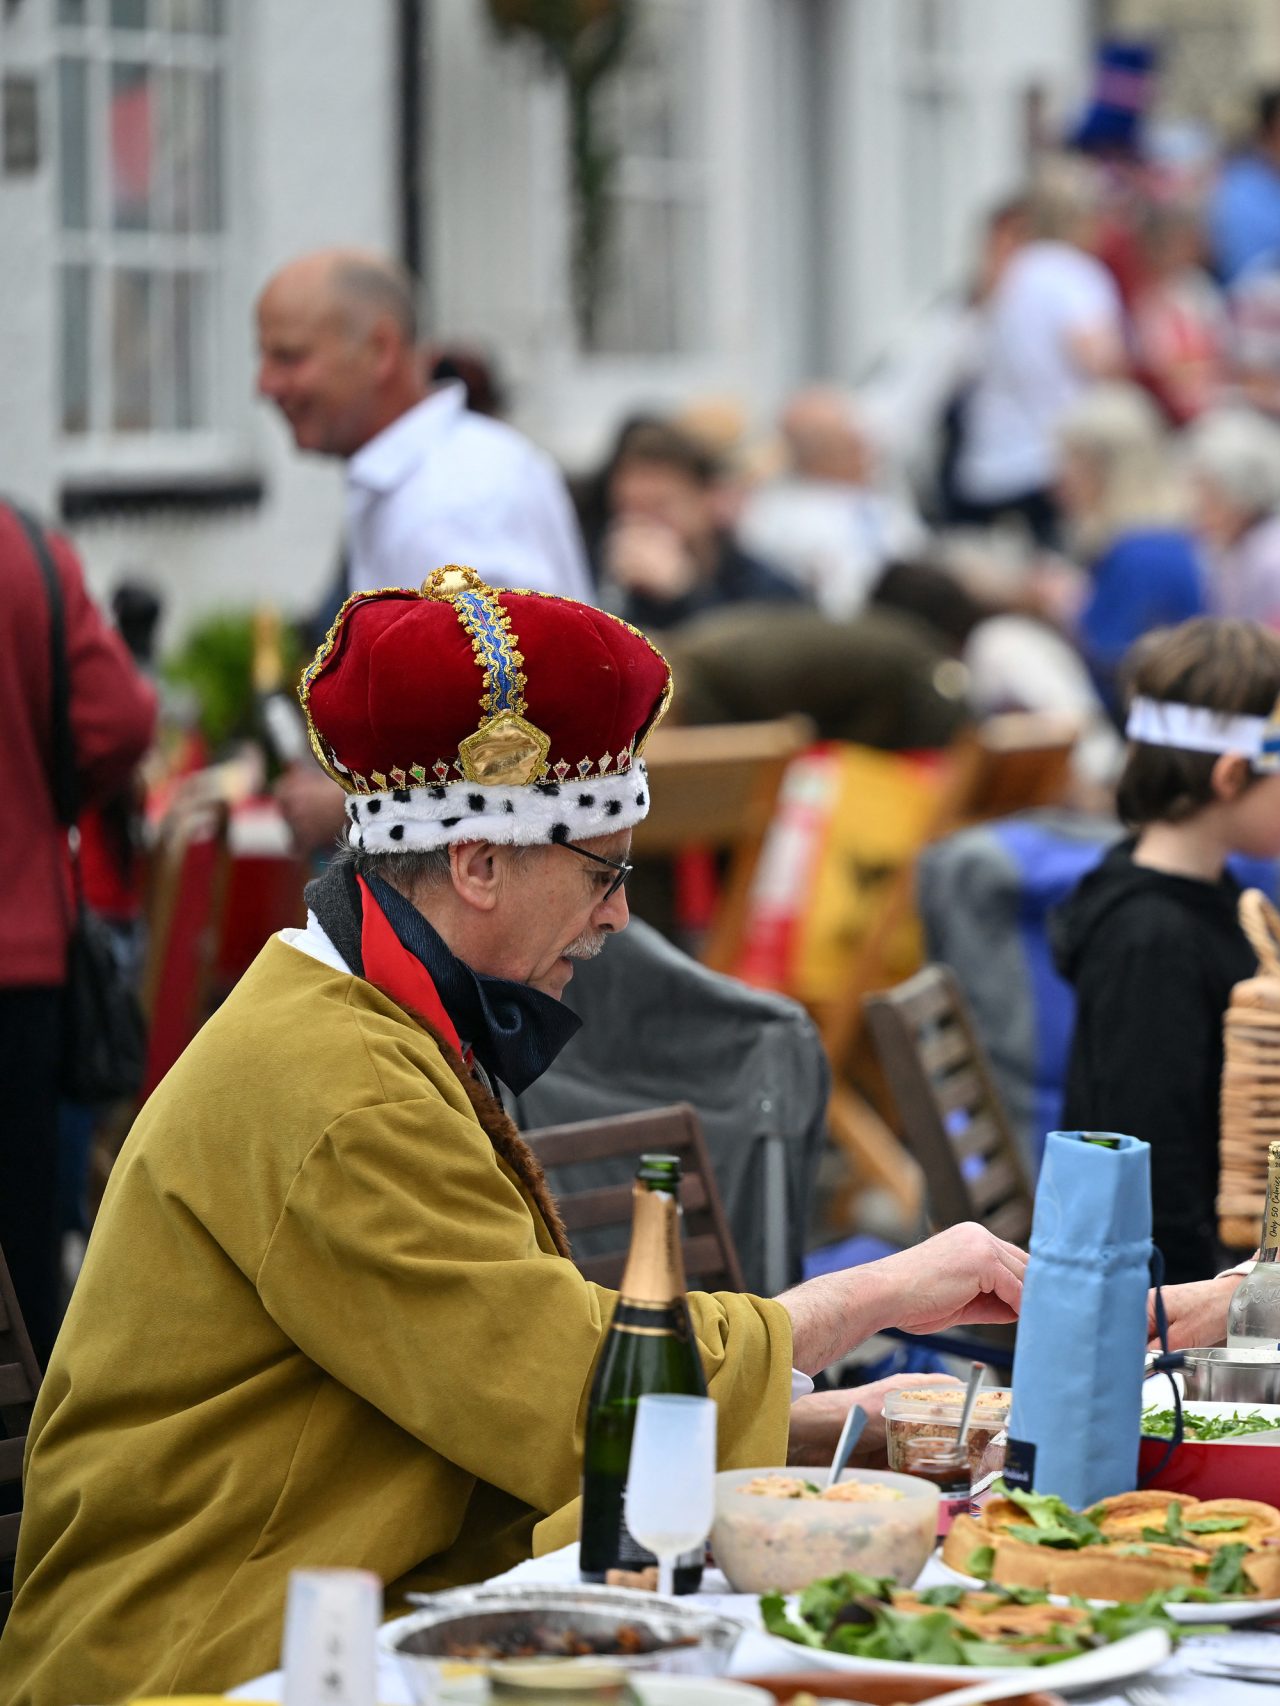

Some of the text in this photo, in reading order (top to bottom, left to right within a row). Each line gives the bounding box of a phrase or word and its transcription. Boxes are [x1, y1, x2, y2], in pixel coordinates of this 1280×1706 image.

[1269, 1176, 1280, 1237] Only 50 Calories
